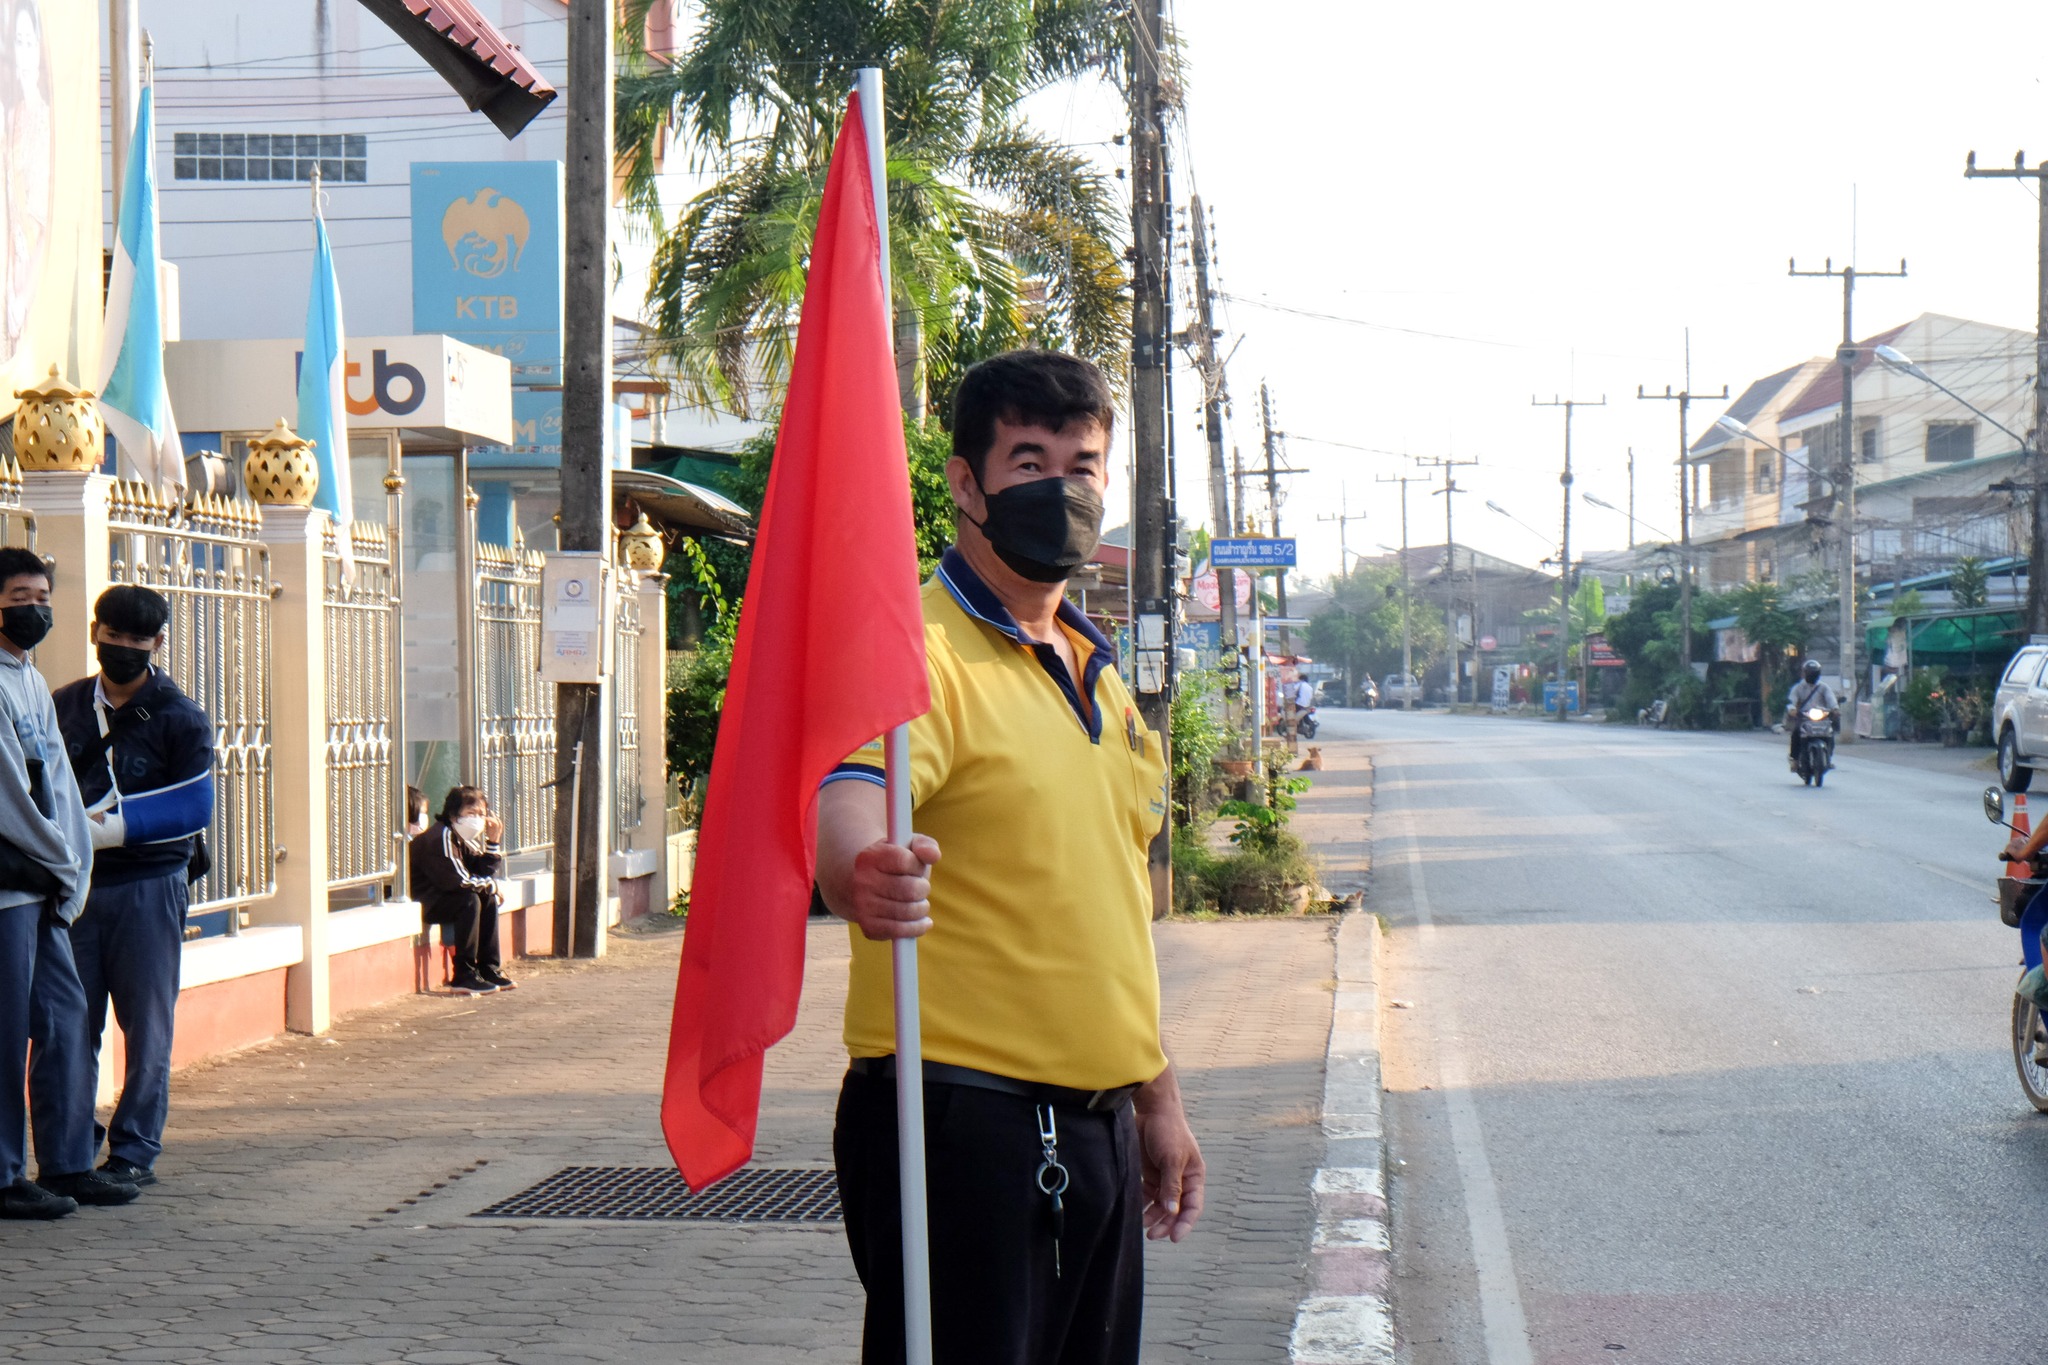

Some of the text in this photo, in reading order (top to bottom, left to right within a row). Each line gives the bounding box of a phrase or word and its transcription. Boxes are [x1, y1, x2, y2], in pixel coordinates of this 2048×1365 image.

[456, 295, 518, 320] KTB
[295, 349, 426, 416] tb
[1259, 545, 1273, 555] ซอย
[1274, 543, 1294, 556] 5/2
[70, 743, 148, 778] PIS
